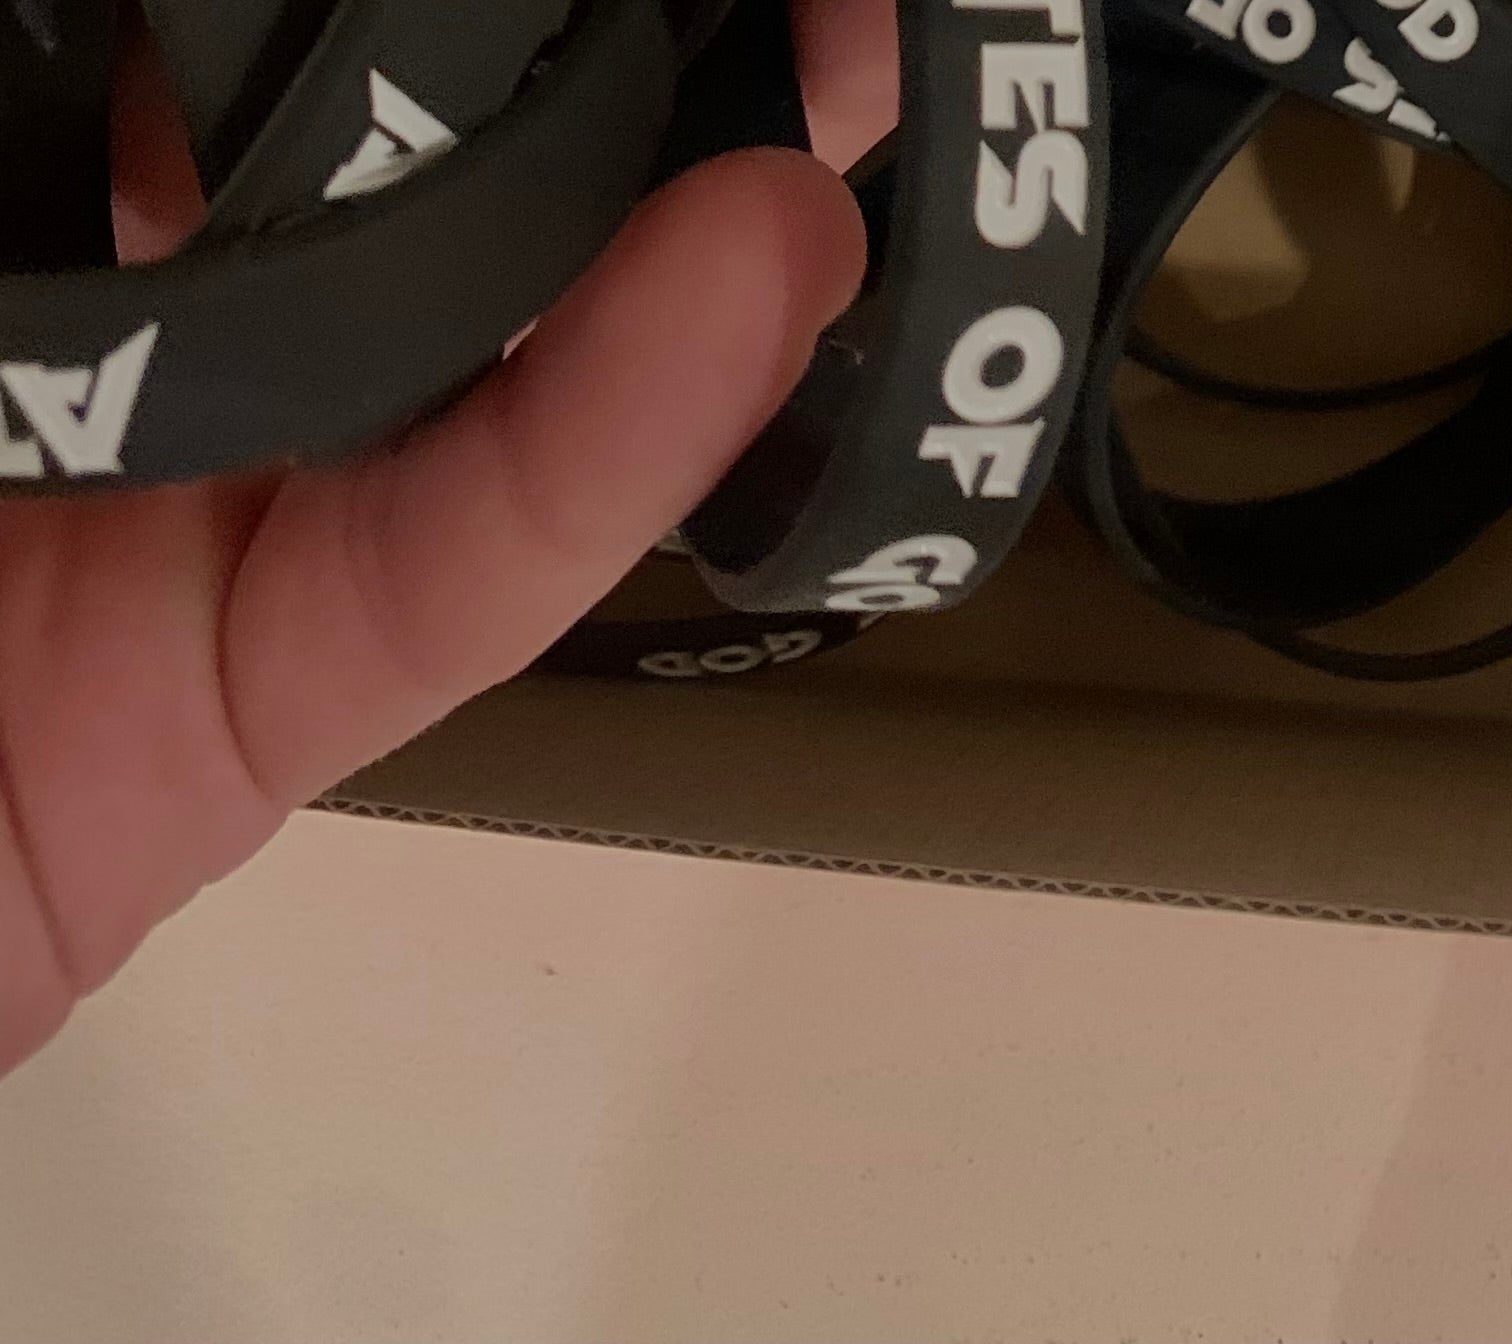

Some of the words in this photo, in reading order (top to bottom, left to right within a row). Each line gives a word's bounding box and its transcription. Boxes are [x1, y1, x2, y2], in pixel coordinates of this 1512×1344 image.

[917, 304, 1065, 499] OF
[824, 533, 978, 612] GO
[637, 627, 823, 678] GOD
